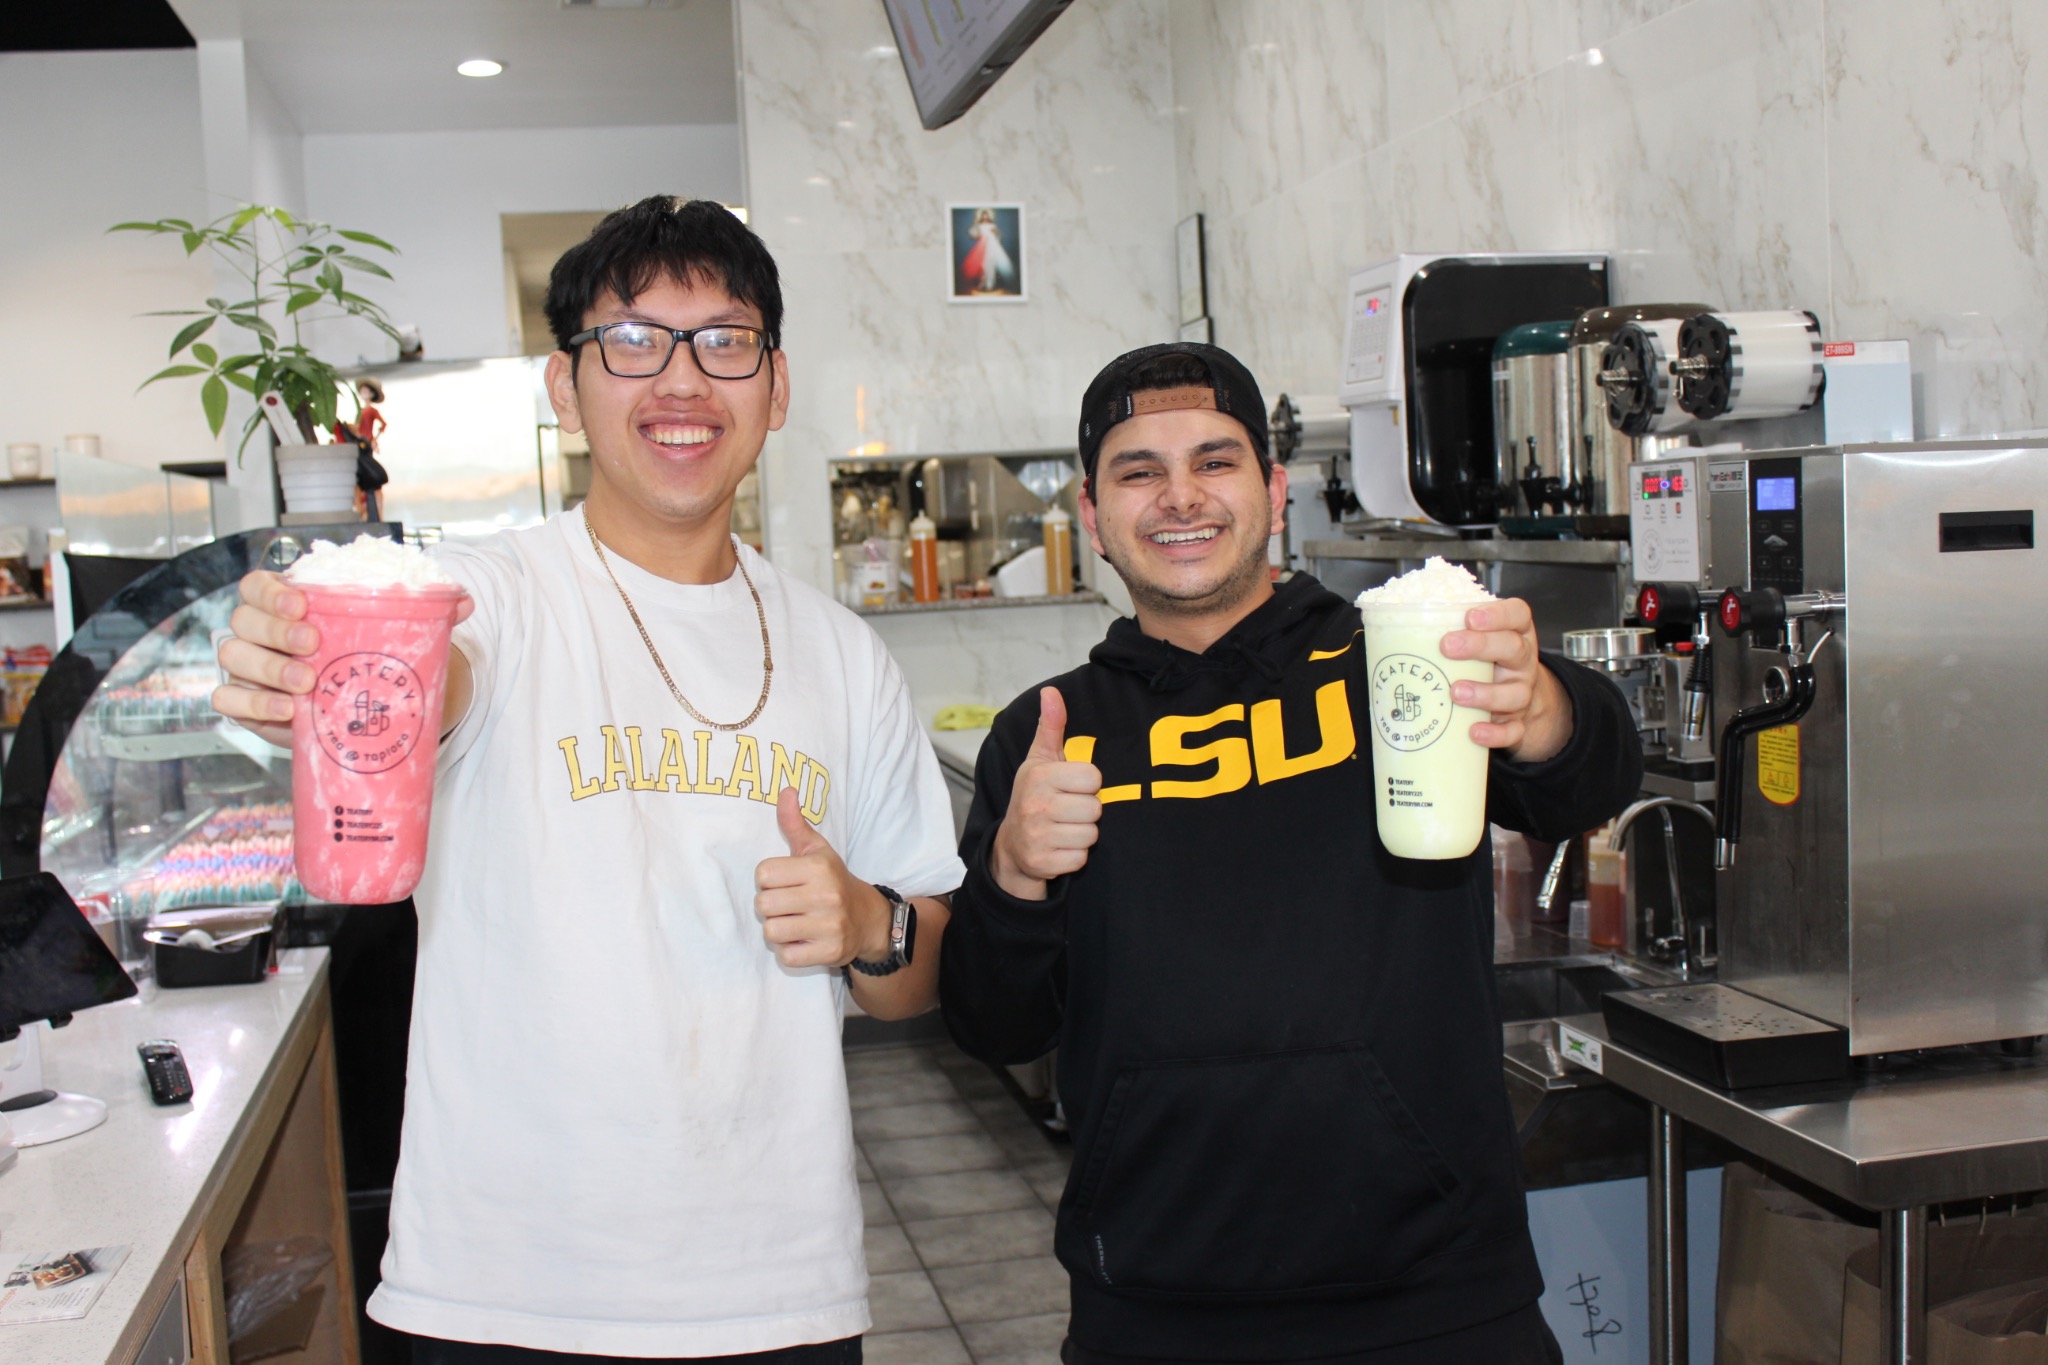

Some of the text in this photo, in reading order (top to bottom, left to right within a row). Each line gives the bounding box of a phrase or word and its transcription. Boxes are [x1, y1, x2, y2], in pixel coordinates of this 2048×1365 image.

[322, 663, 415, 699] TEATERY
[1376, 663, 1443, 692] TEATERY
[558, 725, 831, 825] LALALAND
[1064, 680, 1356, 804] LSU
